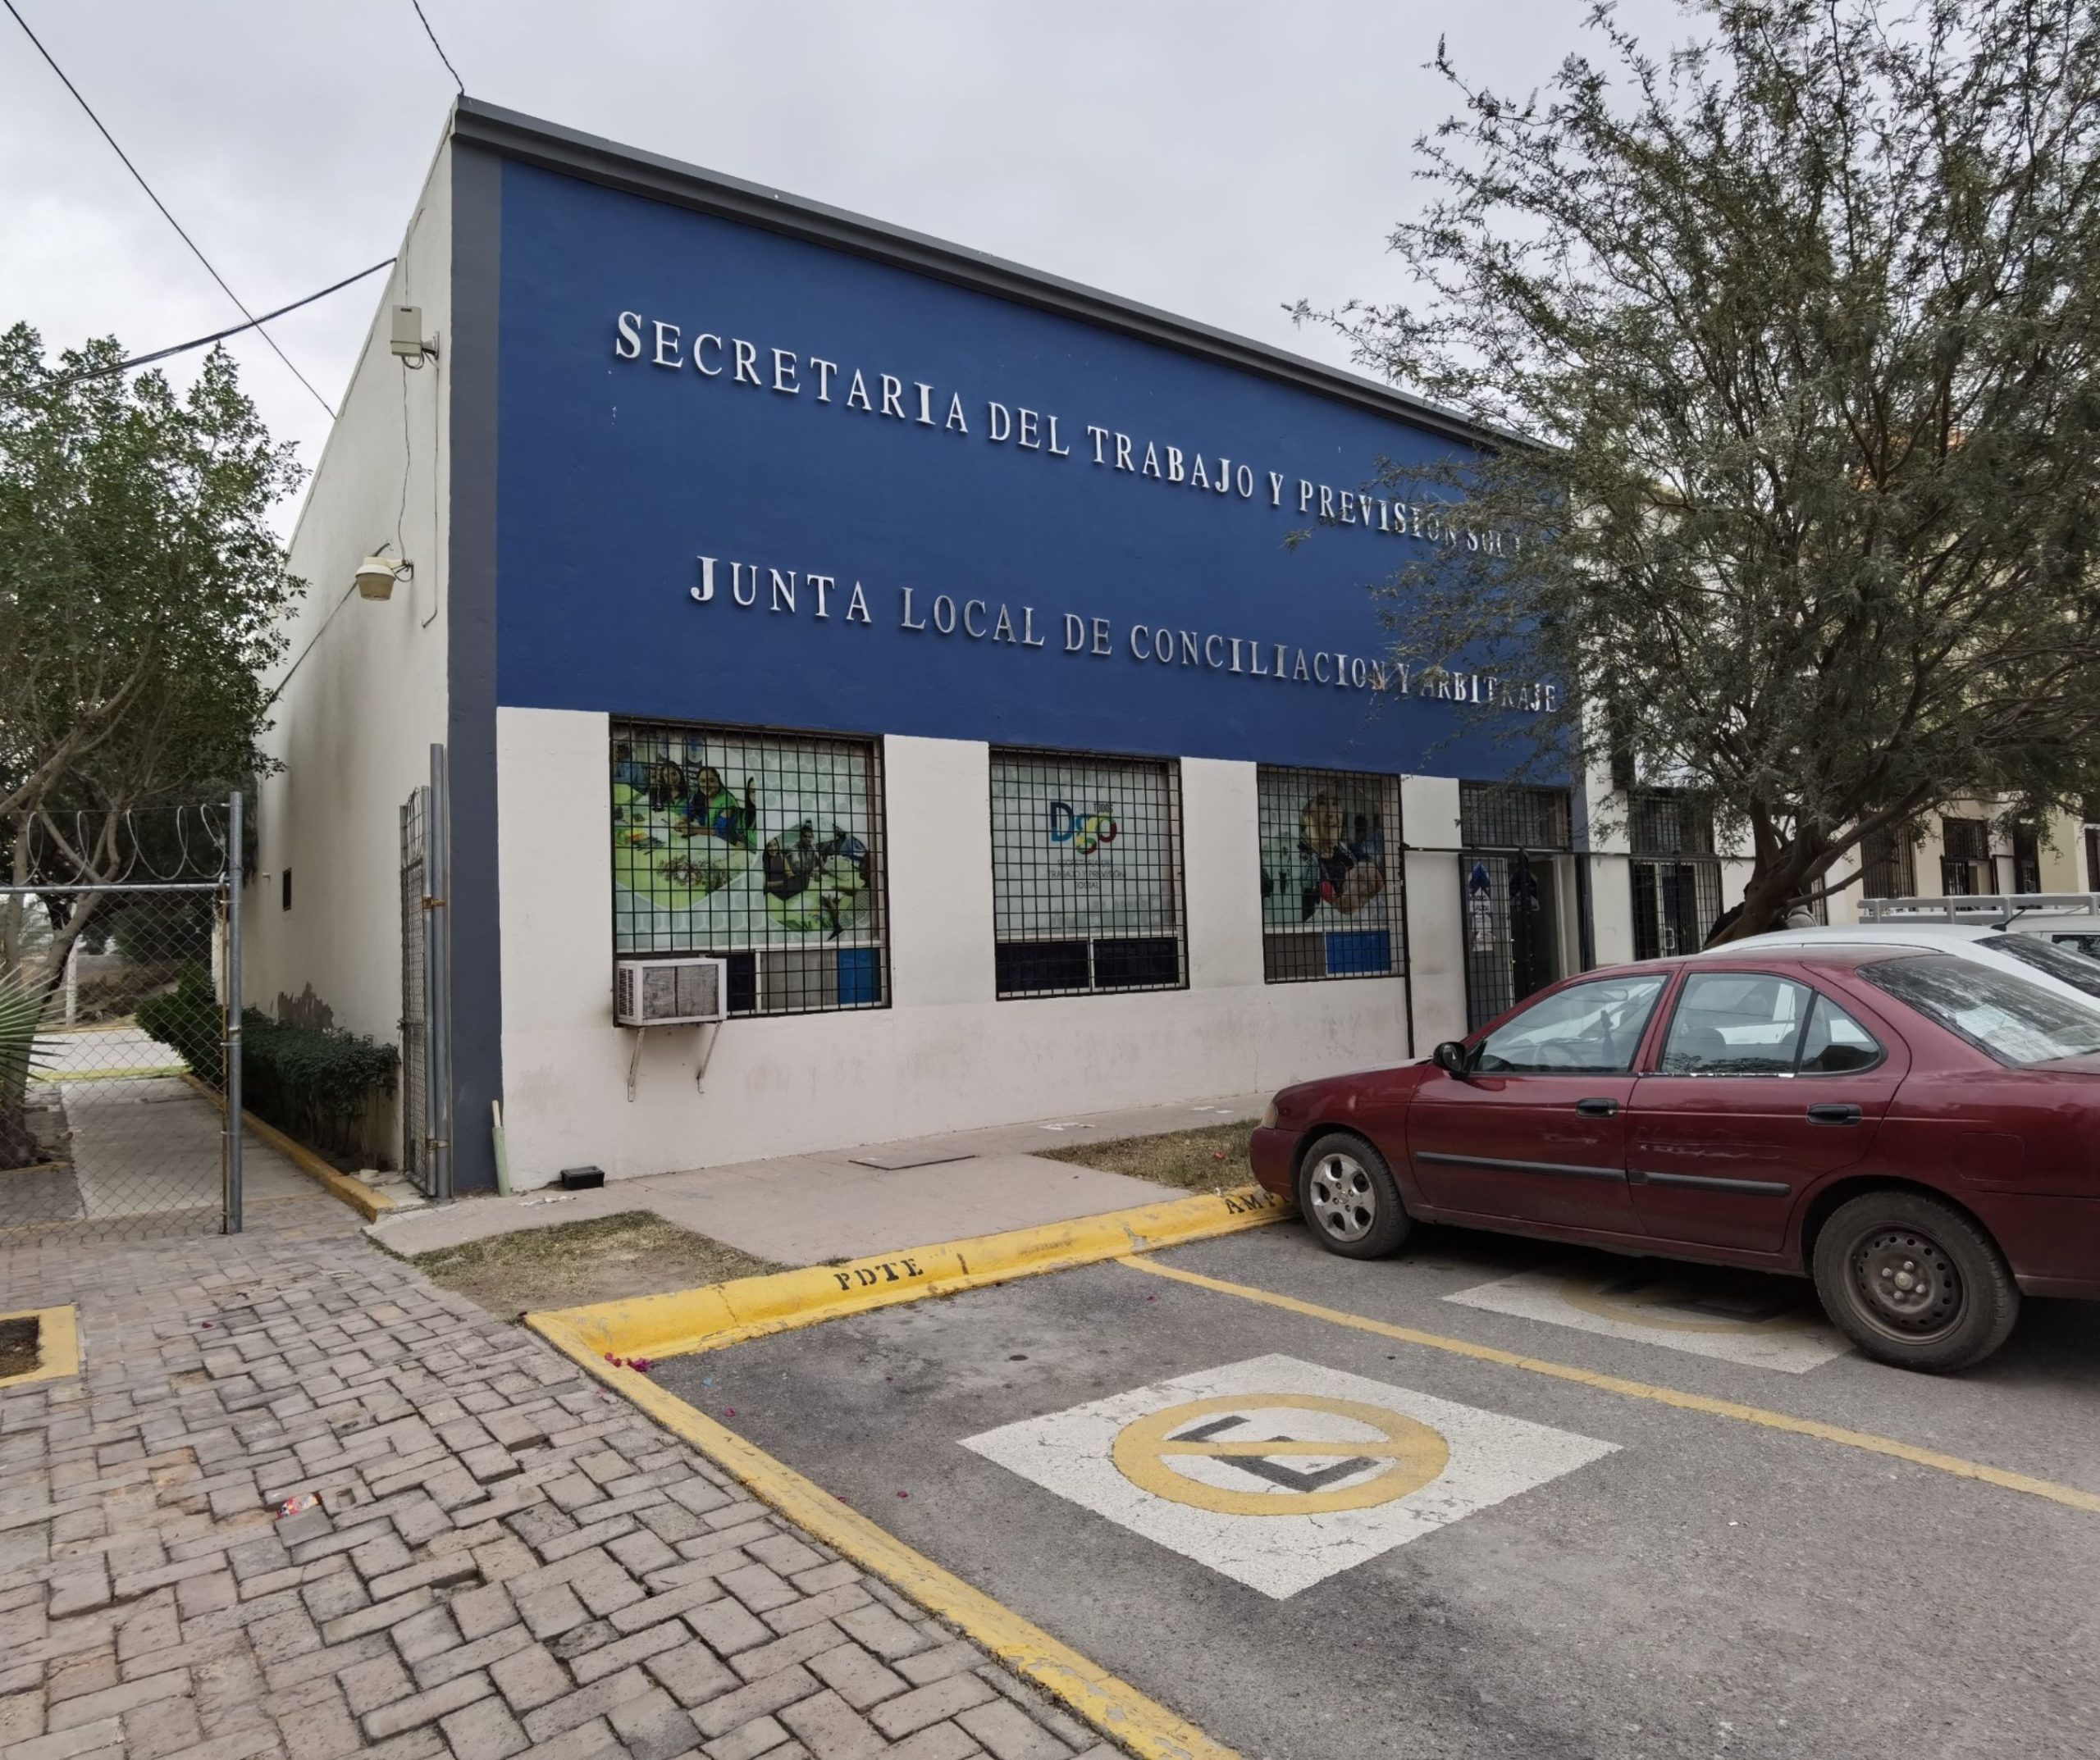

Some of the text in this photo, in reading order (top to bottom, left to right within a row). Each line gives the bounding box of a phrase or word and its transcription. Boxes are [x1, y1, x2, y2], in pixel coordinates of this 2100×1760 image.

[615, 311, 969, 433] SECRETARIA
[988, 401, 1070, 456] DEL
[1087, 425, 1253, 498] TRABAJO
[1268, 471, 1285, 506] Y
[690, 555, 872, 623] JUNTA
[901, 586, 1045, 647] LOCAL
[1064, 613, 1112, 655] DE
[1130, 624, 1386, 691] CONCILIACION
[1397, 663, 1410, 694] Y
